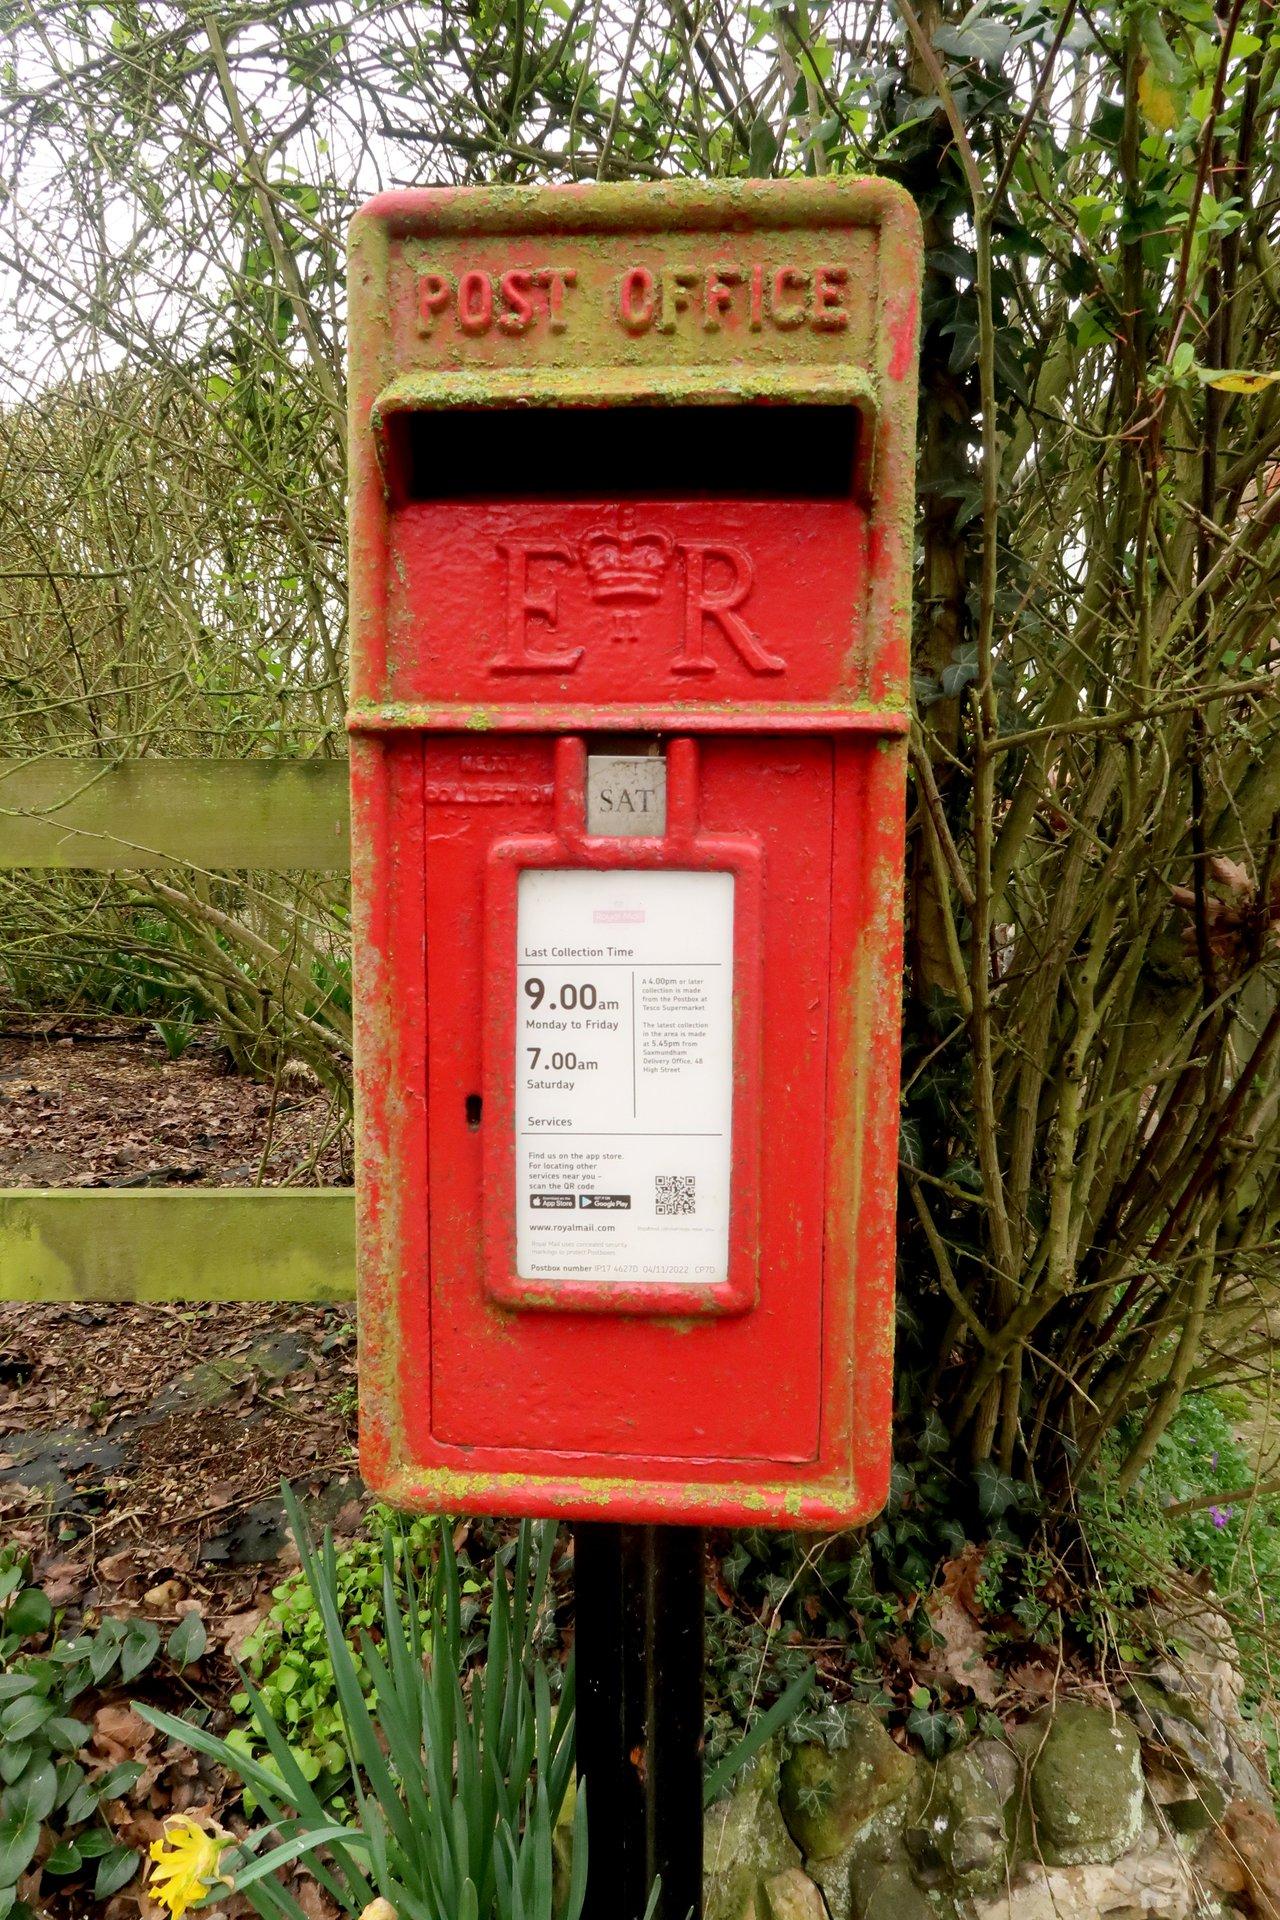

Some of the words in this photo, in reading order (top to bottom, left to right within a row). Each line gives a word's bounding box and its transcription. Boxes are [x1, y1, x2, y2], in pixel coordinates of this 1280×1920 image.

[418, 269, 576, 338] POST
[620, 264, 850, 333] OFFICE
[488, 538, 585, 677] E
[670, 539, 788, 677] R
[426, 783, 554, 802] COLLECTION
[600, 790, 655, 812] SAT
[525, 948, 547, 957] Last
[552, 948, 603, 957] Collection
[607, 948, 634, 957] Time
[524, 978, 619, 1010] 9.00am
[526, 1020, 567, 1030] Monday
[571, 1020, 581, 1030] to
[586, 1020, 618, 1030] Friday
[527, 1048, 598, 1070] 7.00am
[527, 1080, 574, 1091] Saturday
[528, 1117, 572, 1126] Services
[544, 1162, 574, 1171] locating
[530, 1224, 615, 1233] www.royalmail.com
